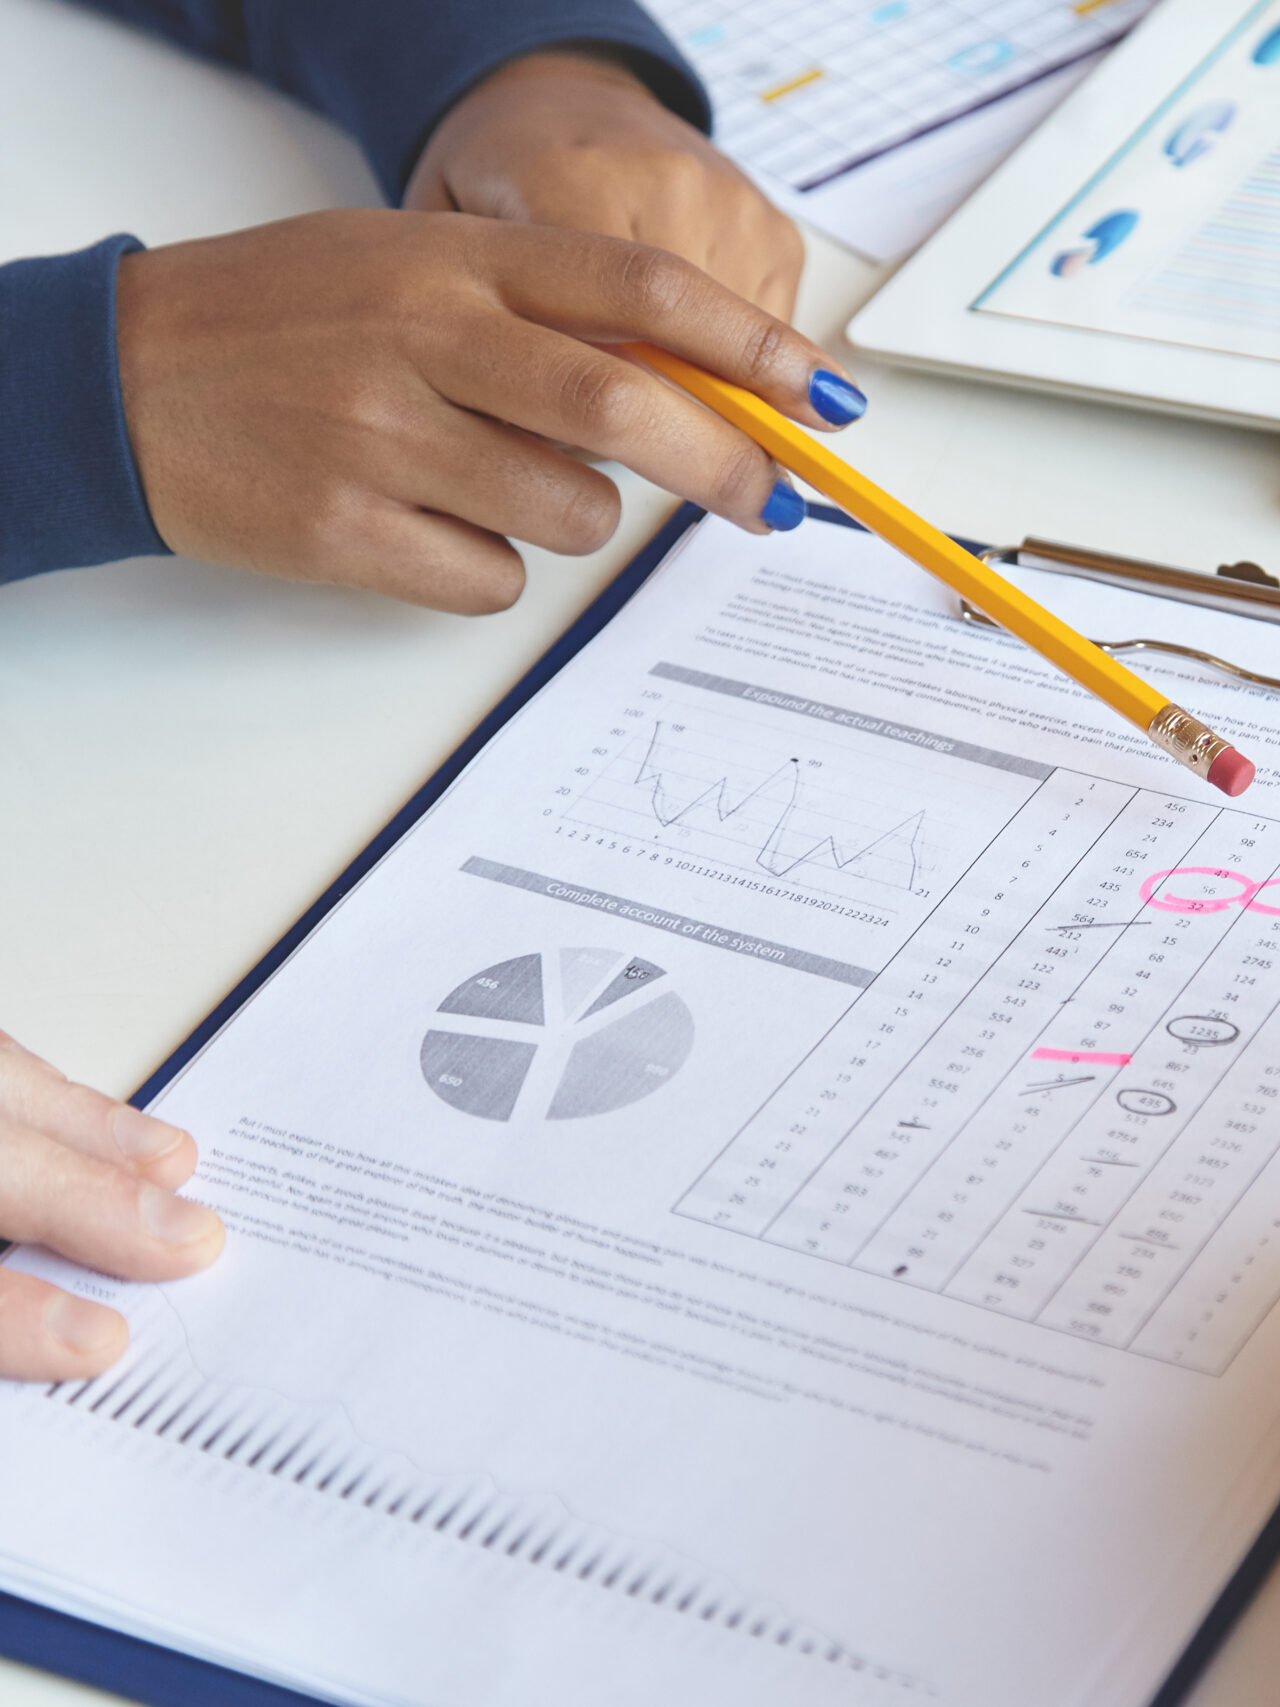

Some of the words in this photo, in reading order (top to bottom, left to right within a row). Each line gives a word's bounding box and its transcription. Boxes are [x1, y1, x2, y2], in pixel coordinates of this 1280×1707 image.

[1153, 667, 1175, 676] pain
[1177, 673, 1195, 681] was
[1196, 676, 1220, 687] born
[1221, 683, 1241, 692] and
[743, 687, 808, 710] Expound
[808, 705, 833, 717] the
[835, 714, 883, 730] actual
[883, 725, 954, 751] teachings
[890, 675, 942, 692] undertakes
[943, 688, 988, 705] laborious
[988, 700, 1028, 715] physical
[1071, 722, 1104, 735] except
[1105, 730, 1117, 738] to
[1116, 734, 1148, 746] obtain
[1195, 709, 1222, 721] know
[1224, 716, 1246, 727] how
[1246, 722, 1258, 730] to
[998, 714, 1017, 724] one
[1018, 720, 1040, 729] who
[1040, 725, 1072, 738] avoids
[1079, 735, 1102, 745] pain
[1103, 740, 1125, 751] that
[1124, 747, 1174, 762] produces
[808, 759, 823, 768] 99
[1151, 817, 1174, 828] 234
[1240, 838, 1256, 847] 98
[1164, 802, 1187, 813] 456
[1253, 822, 1267, 832] 11
[1141, 834, 1157, 843] 24
[1227, 853, 1242, 863] 76
[1125, 849, 1148, 860] 654
[1214, 870, 1229, 879] 43
[915, 888, 930, 898] 21
[1112, 865, 1134, 876] 443
[1202, 885, 1216, 895] 56
[1099, 881, 1120, 892] 435
[1187, 902, 1204, 911] 32
[546, 883, 618, 909] Complete
[619, 905, 680, 929] account
[682, 924, 703, 934] of
[702, 929, 728, 943] the
[730, 938, 785, 960] system
[1086, 897, 1108, 908] 423
[1174, 918, 1191, 928] 22
[1069, 912, 1098, 926] 564
[1161, 936, 1177, 946] 15
[1241, 955, 1272, 969] 2745
[1056, 929, 1083, 942] 212
[1148, 953, 1165, 963] 68
[1233, 974, 1256, 986] 124
[476, 977, 499, 989] 456
[1031, 962, 1055, 974] 122
[1121, 986, 1138, 997] 32
[1045, 946, 1068, 958] 443
[1135, 970, 1151, 979] 44
[1222, 992, 1239, 1002] 34
[1002, 995, 1027, 1007] 543
[1093, 1020, 1111, 1030] 87
[1017, 979, 1041, 990] 123
[1107, 1003, 1125, 1014] 99
[1189, 1025, 1220, 1041] 1235
[438, 1073, 463, 1086] 650
